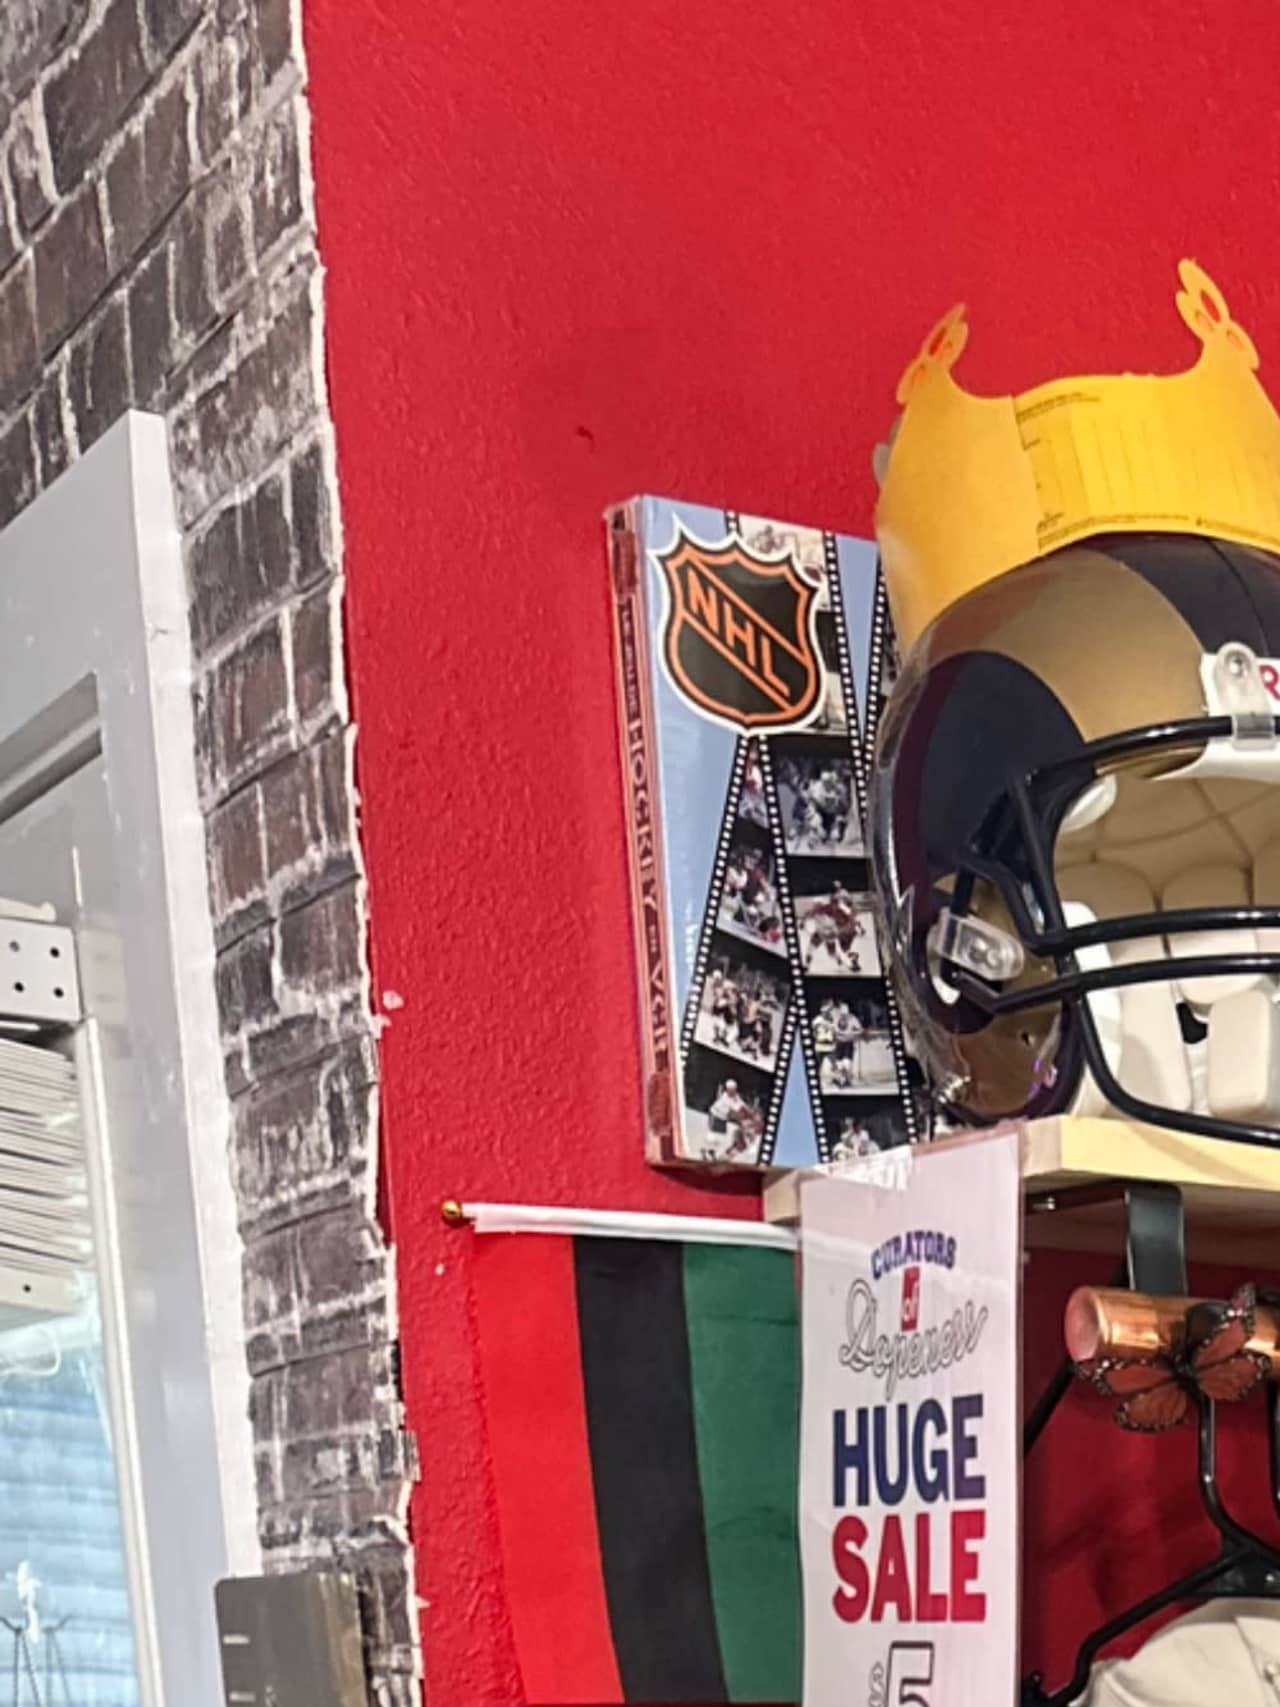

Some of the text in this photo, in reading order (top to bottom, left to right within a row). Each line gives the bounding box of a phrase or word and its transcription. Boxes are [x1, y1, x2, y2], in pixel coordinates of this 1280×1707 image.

[688, 569, 791, 698] NHL
[870, 1230, 957, 1281] CURATORS
[832, 1393, 985, 1507] HUGE
[831, 1508, 987, 1623] SALE
